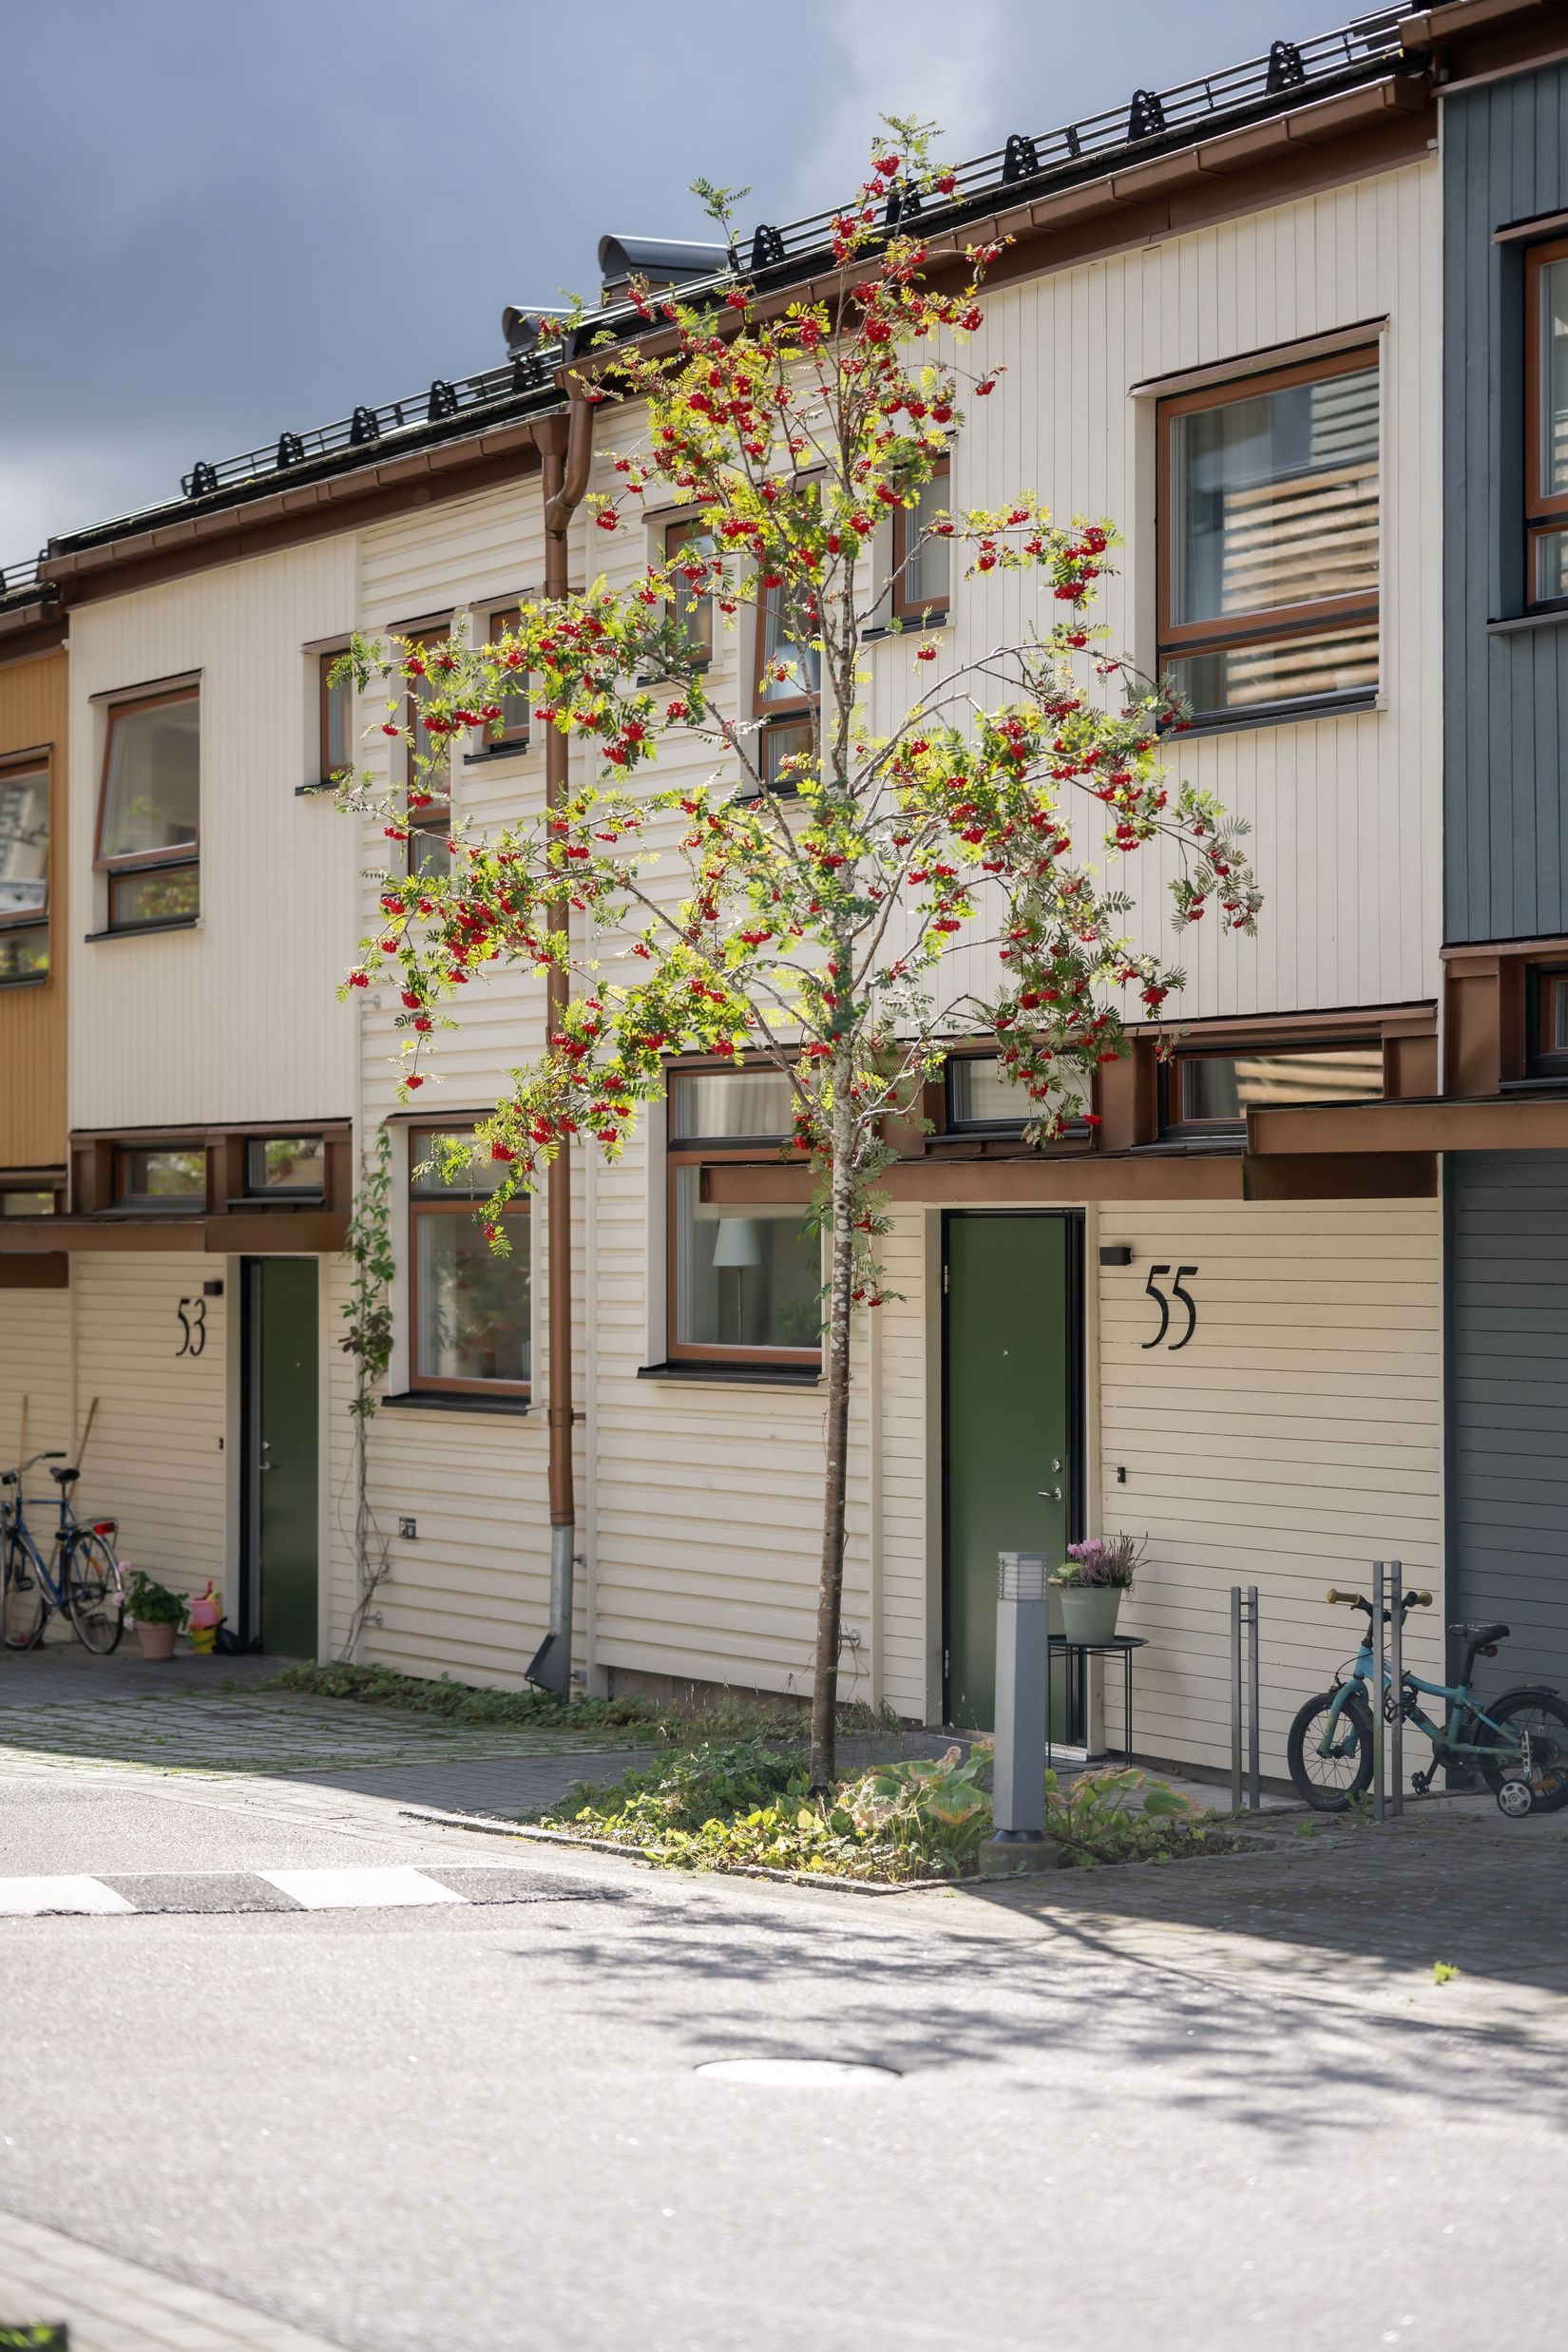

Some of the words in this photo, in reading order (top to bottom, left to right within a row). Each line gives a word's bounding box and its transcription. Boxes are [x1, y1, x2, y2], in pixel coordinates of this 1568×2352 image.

[175, 1298, 206, 1356] 53
[1141, 1265, 1198, 1350] 55
[400, 1520, 406, 1535] P
